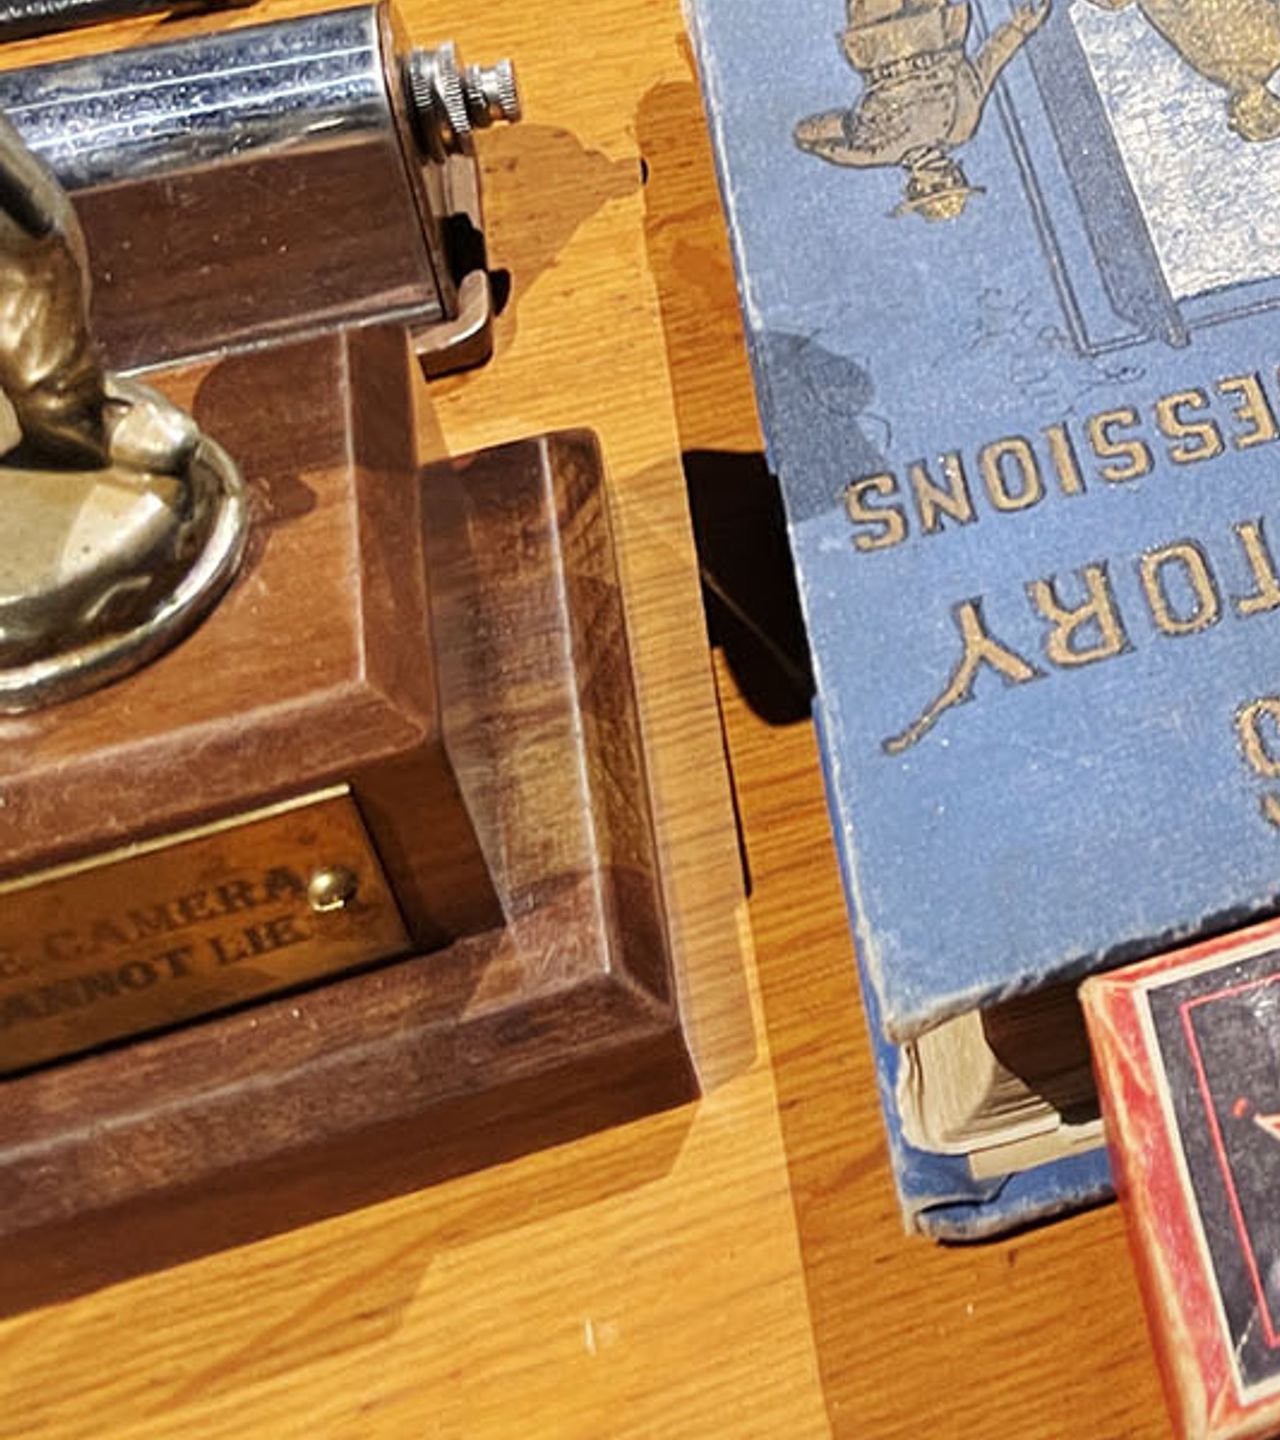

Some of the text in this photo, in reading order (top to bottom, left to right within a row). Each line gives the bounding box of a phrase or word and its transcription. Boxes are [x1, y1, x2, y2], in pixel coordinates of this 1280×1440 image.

[42, 865, 307, 960] CAMERA
[0, 945, 195, 1026] ANNOT
[211, 914, 298, 968] LIE
